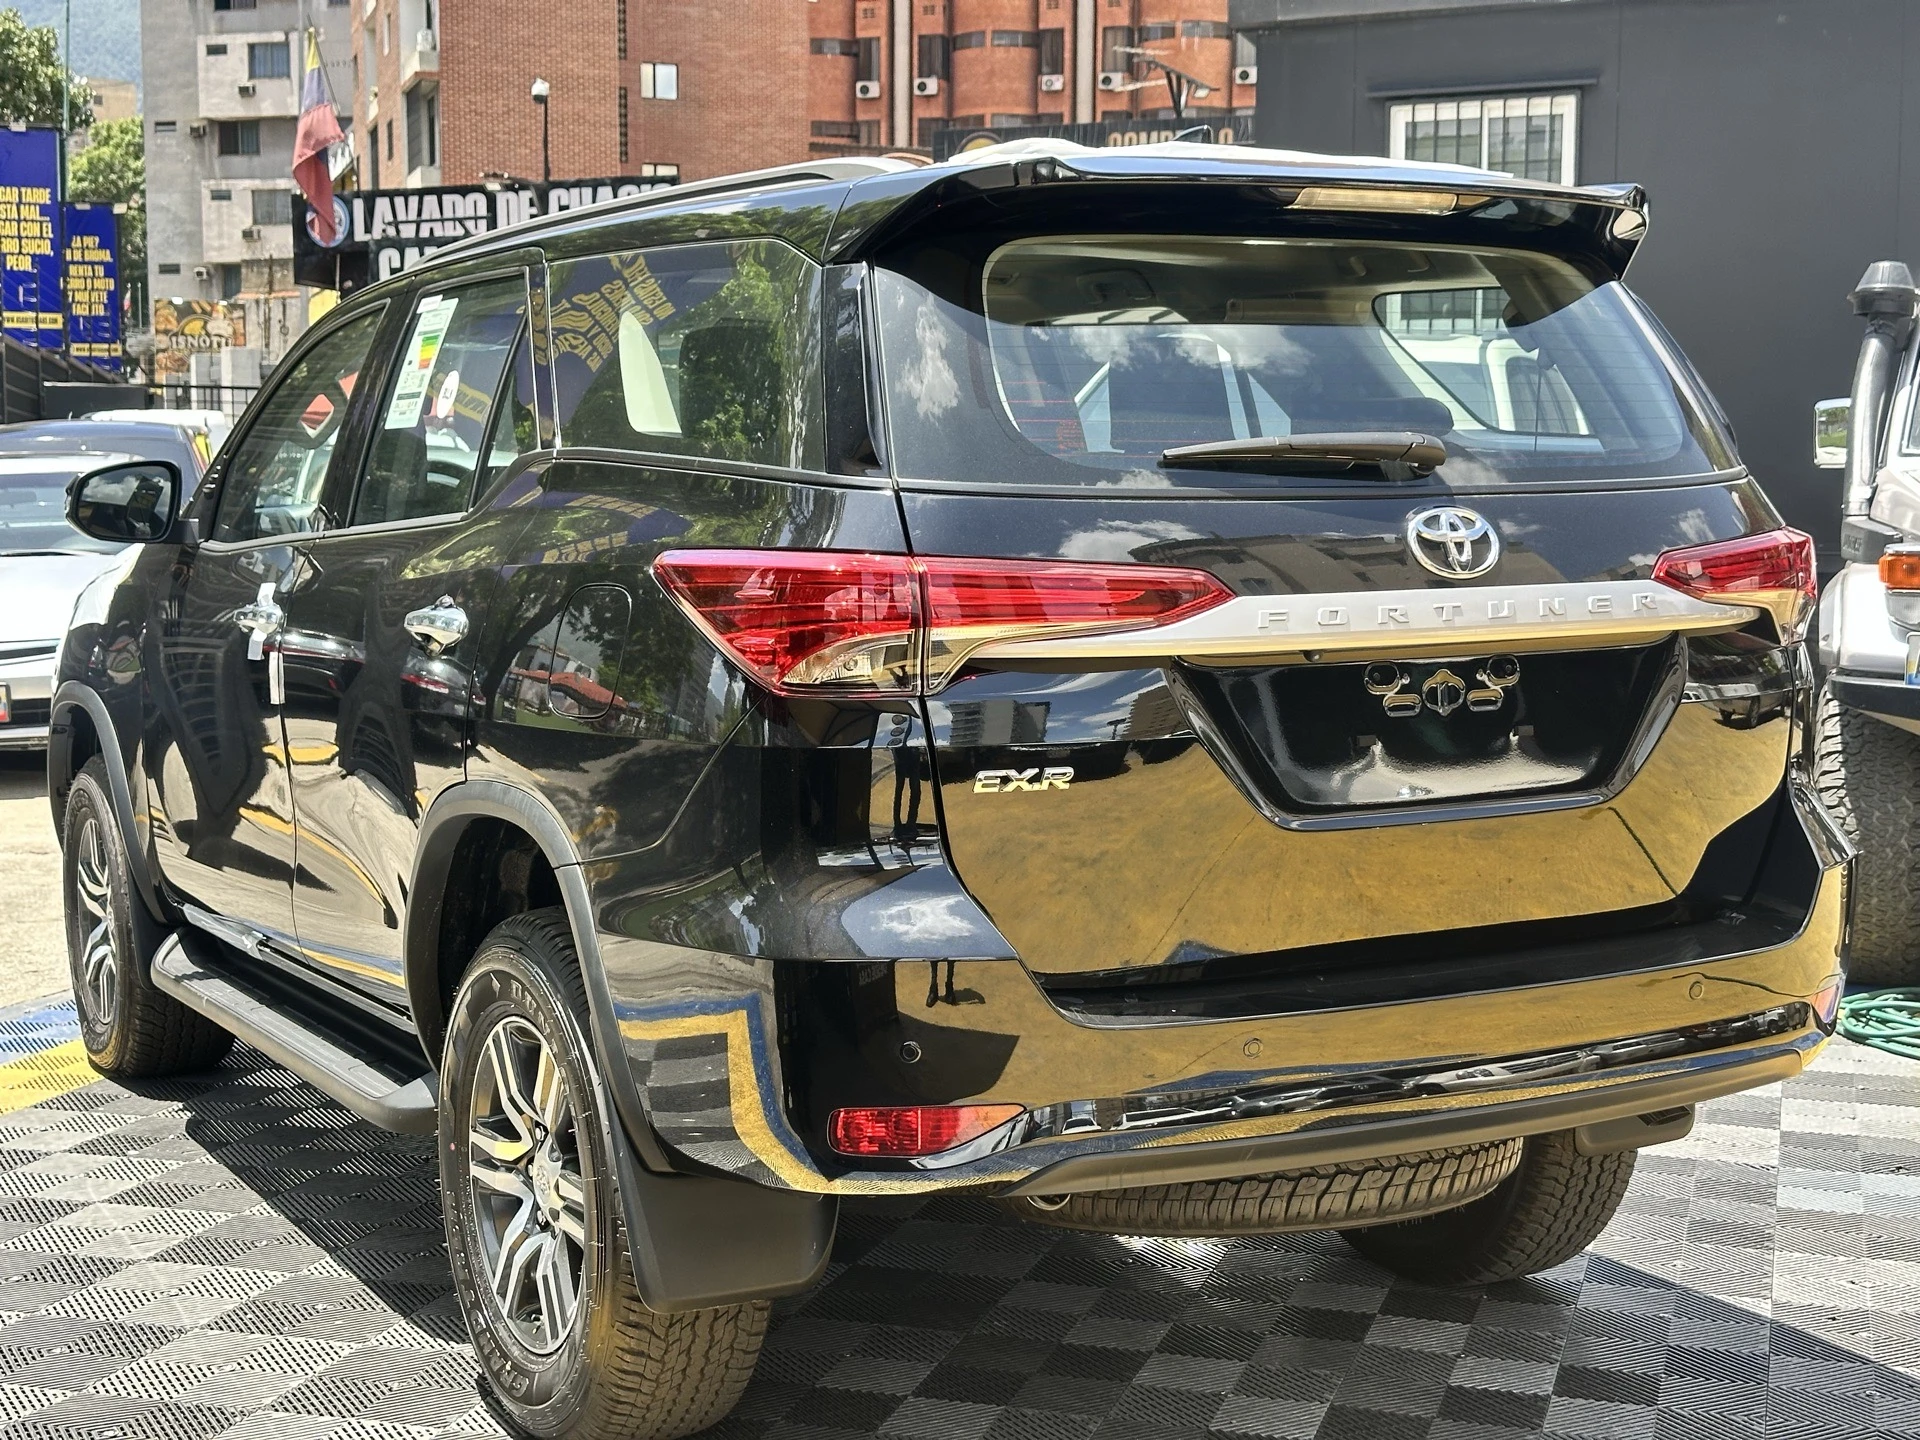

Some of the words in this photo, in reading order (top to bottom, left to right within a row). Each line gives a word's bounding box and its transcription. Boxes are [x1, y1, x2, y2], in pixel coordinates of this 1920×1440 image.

[20, 187, 51, 204] TARDE
[352, 191, 488, 242] LAVADO
[20, 221, 40, 237] CON
[69, 264, 93, 277] RENTA
[94, 264, 105, 278] TU
[93, 277, 115, 291] MOTO
[1257, 591, 1659, 629] FORTUNER
